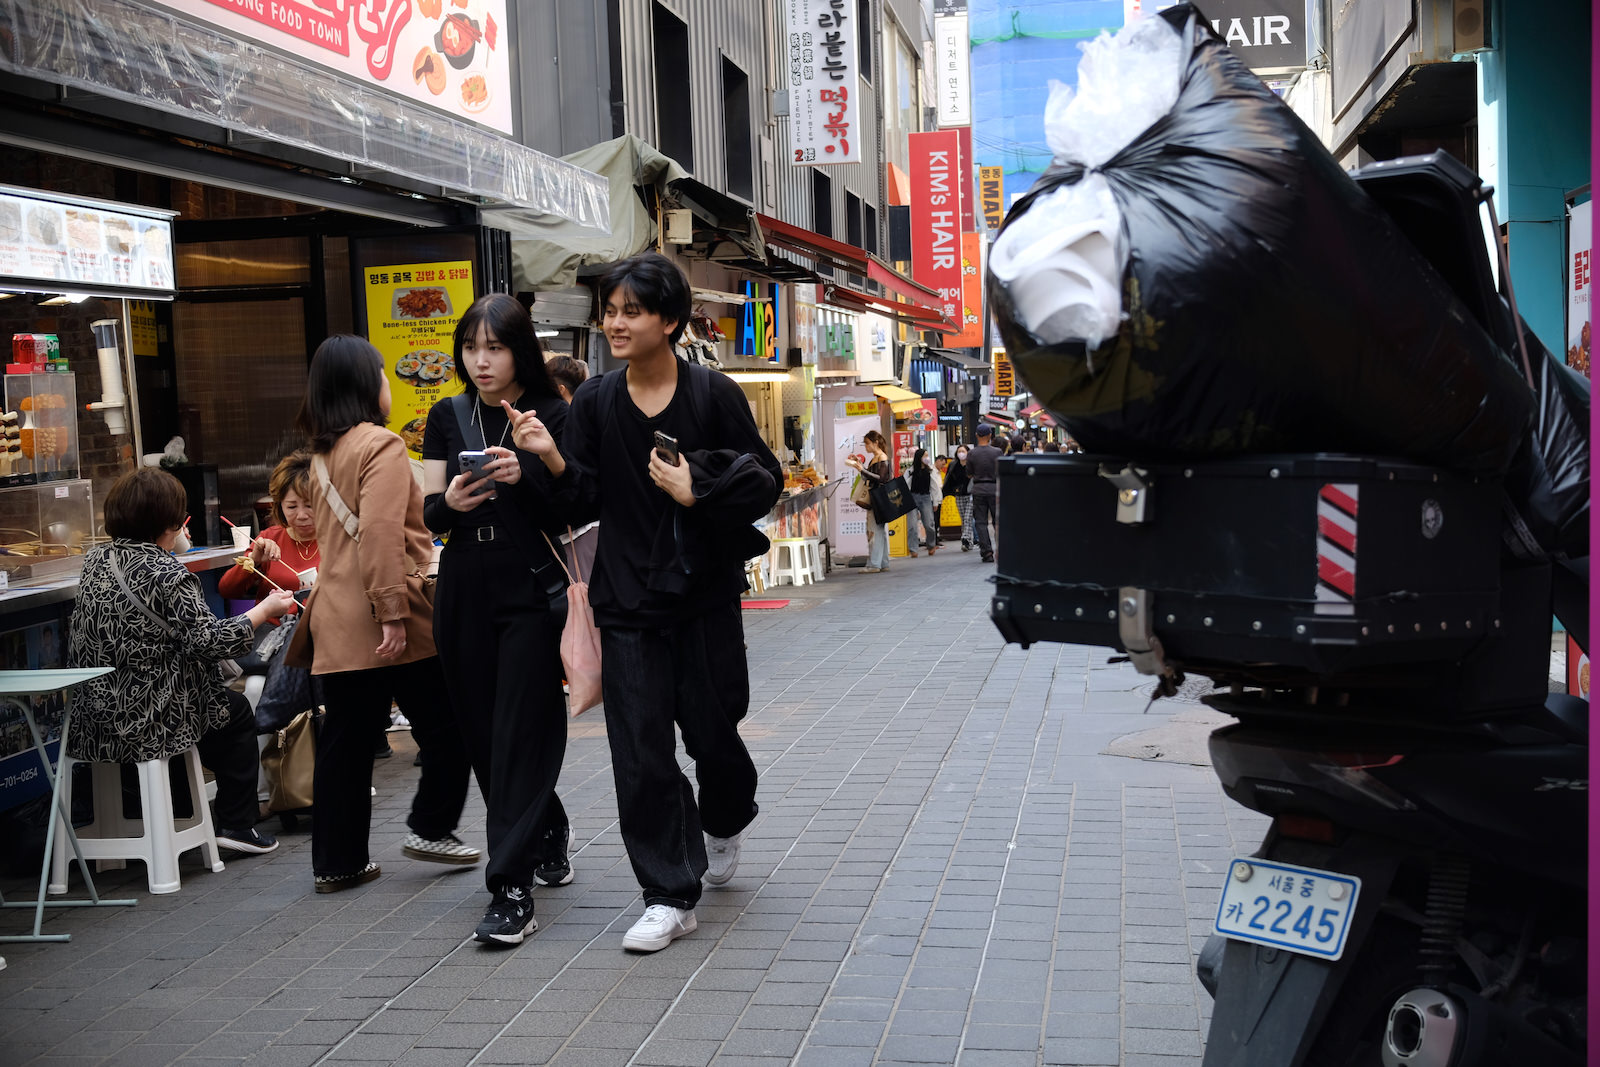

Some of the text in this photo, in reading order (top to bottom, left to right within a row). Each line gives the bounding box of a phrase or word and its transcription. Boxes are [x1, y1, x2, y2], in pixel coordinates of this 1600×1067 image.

[271, 2, 303, 30] FOOD
[308, 18, 342, 47] TOWN
[947, 36, 960, 114] 디저트 연구소
[820, 86, 849, 156] 떡볶이
[983, 181, 1000, 230] MAR
[931, 211, 955, 271] HAIR
[370, 268, 469, 285] 명동 골목 김밥 & 닭발
[998, 361, 1012, 394] MART
[1255, 784, 1296, 795] HONDA
[1268, 875, 1316, 898] 서울 중
[1225, 895, 1340, 943] 카 2245
